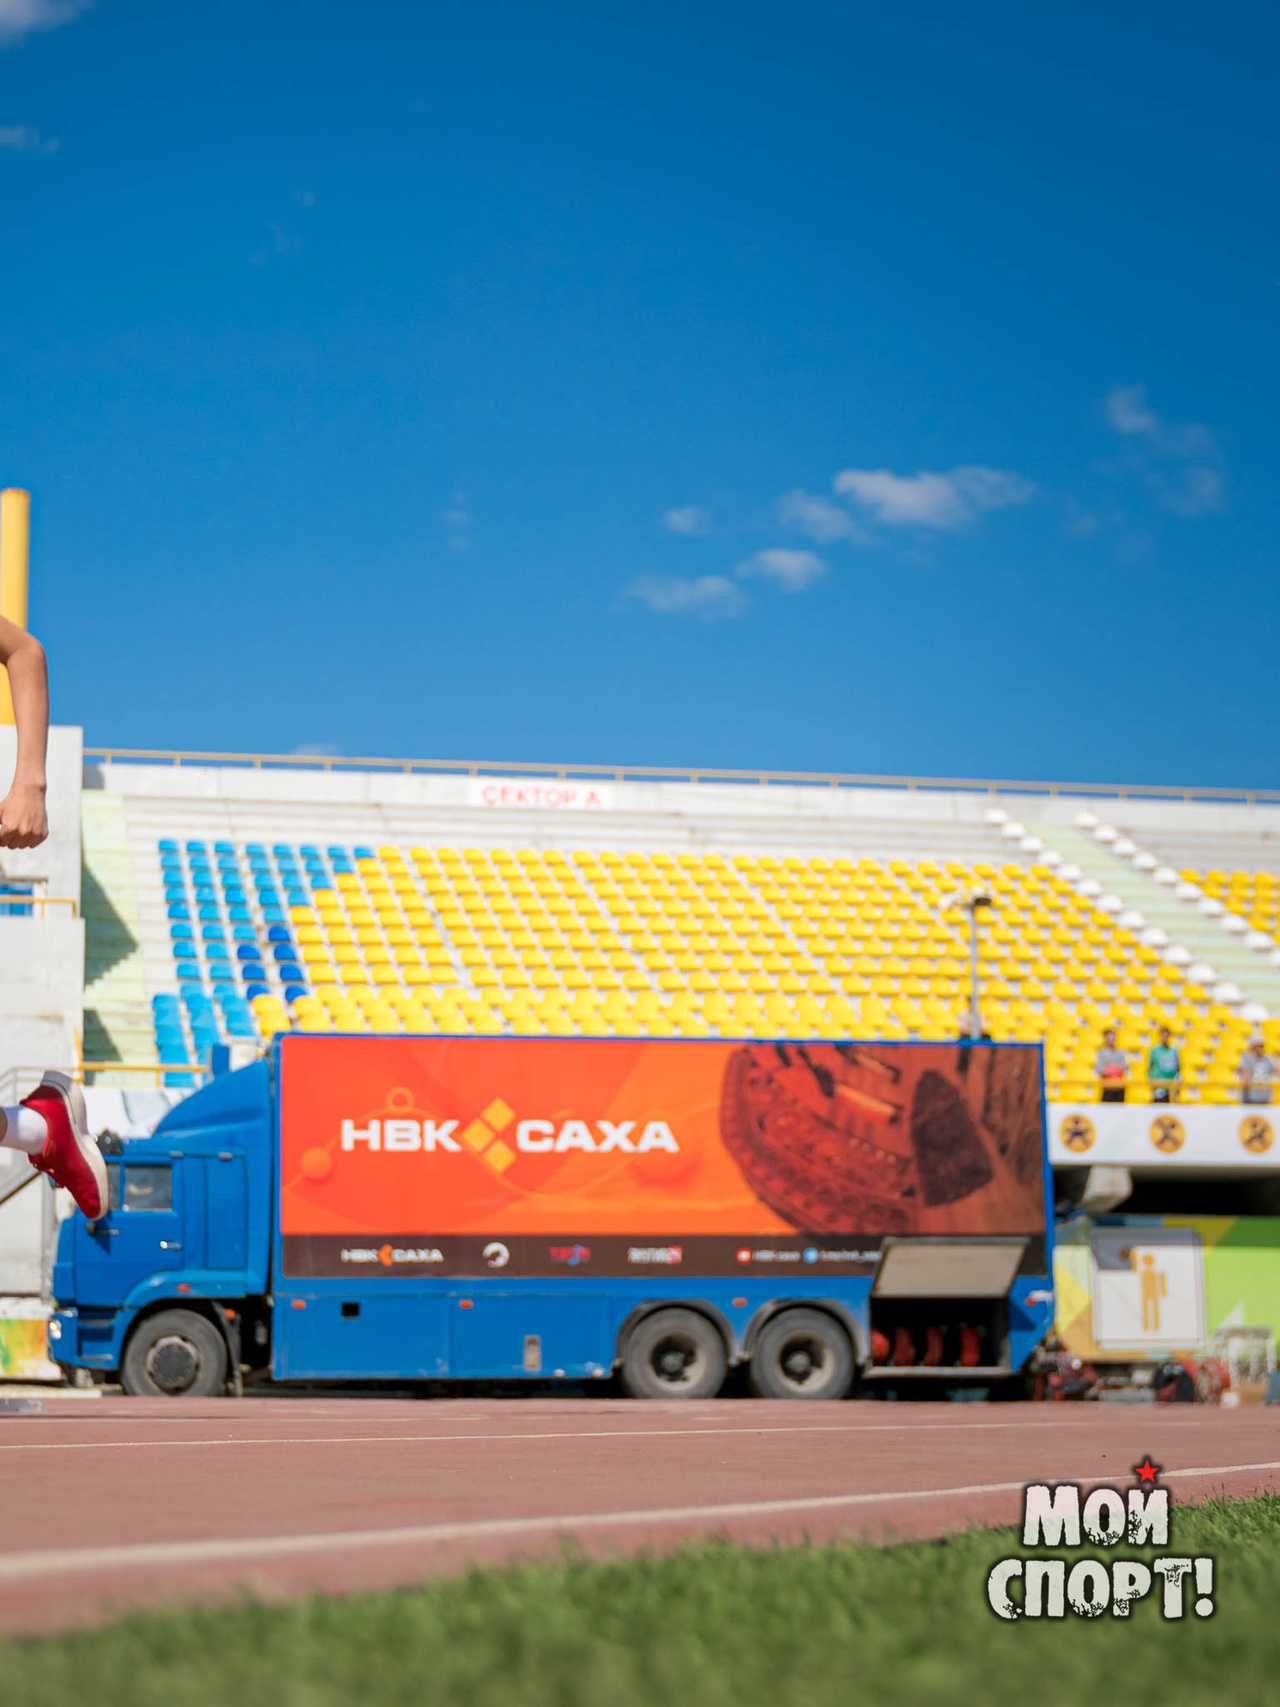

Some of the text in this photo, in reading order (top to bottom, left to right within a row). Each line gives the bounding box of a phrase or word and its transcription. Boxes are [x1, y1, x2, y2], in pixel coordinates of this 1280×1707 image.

[482, 784, 603, 809] СЕКТОР А
[341, 1118, 680, 1153] НВК САХА
